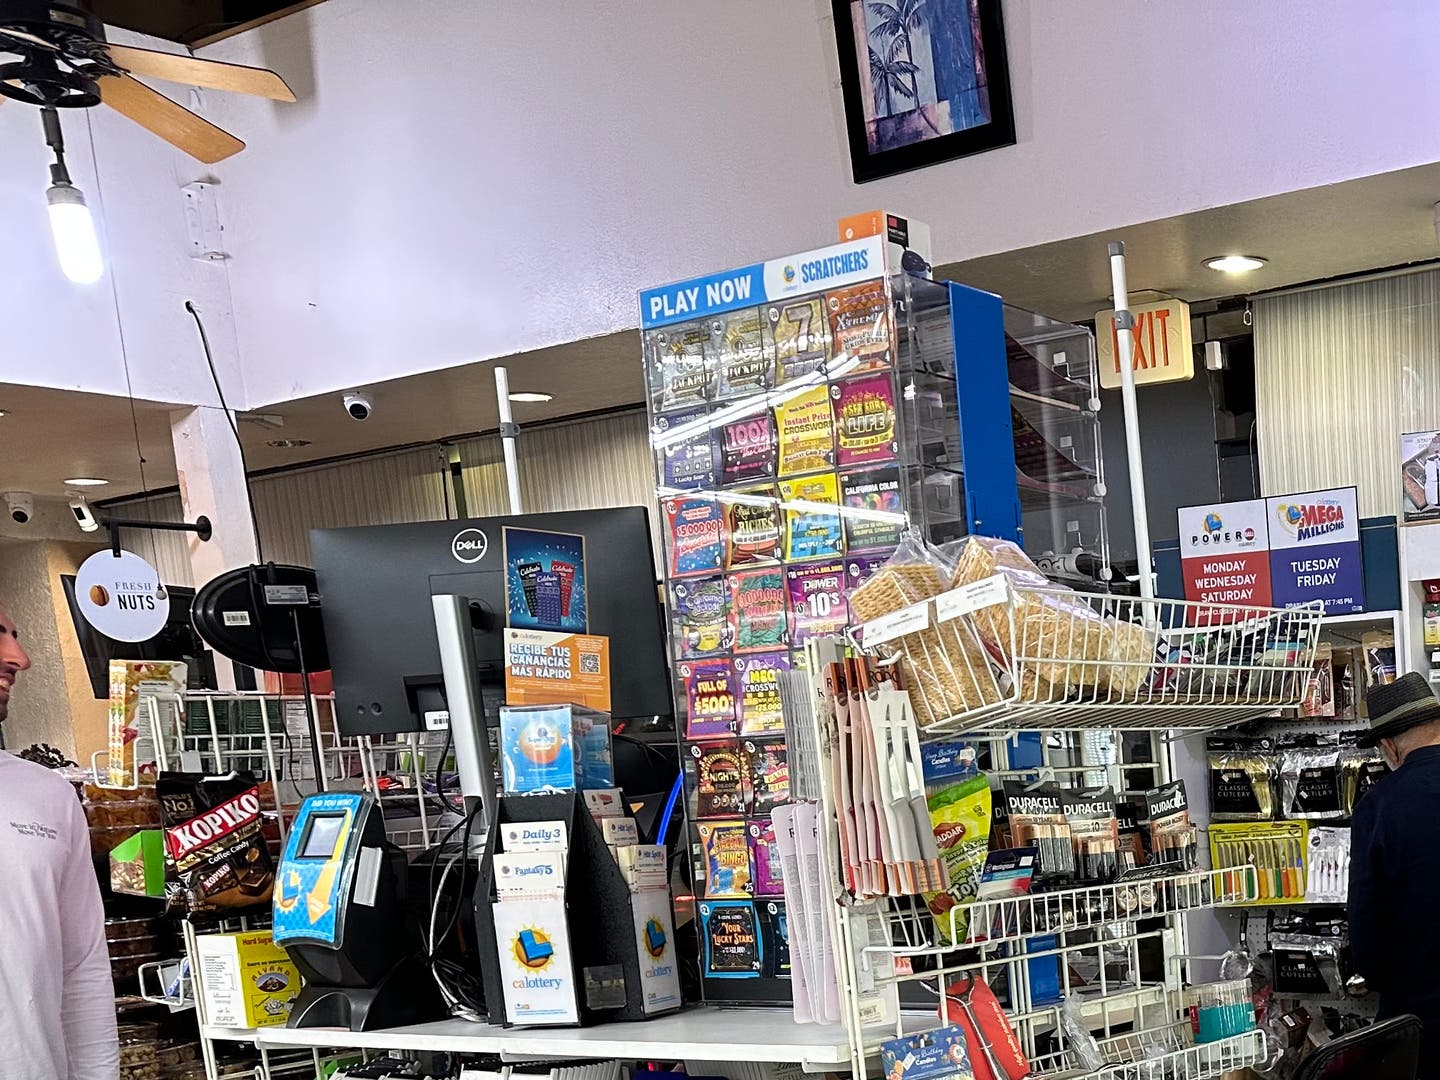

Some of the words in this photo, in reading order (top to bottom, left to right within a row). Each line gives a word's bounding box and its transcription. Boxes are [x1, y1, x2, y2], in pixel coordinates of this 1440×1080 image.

[801, 250, 867, 283] SCRATCHERS
[651, 288, 700, 320] PLAY
[707, 275, 752, 306] NOW
[848, 413, 886, 434] LIFE
[845, 485, 878, 495] CALIFORNIA
[880, 481, 898, 491] COLOR
[1299, 504, 1344, 528] MEGA
[1298, 521, 1344, 541] MILLIONS
[457, 538, 484, 551] DELL
[1203, 560, 1246, 574] MONDAY
[1291, 558, 1341, 572] TUESDAY
[114, 581, 152, 592] FRESH
[803, 577, 839, 592] POWER
[1195, 574, 1257, 589] WEDNESDAY
[1298, 573, 1336, 588] FRIDAY
[118, 594, 156, 611] NUTS
[1201, 588, 1254, 603] SATURDAY
[510, 643, 547, 656] RECIBE
[551, 646, 571, 658] TUS
[510, 655, 571, 668] GANANCIAS
[698, 681, 715, 692] FULL
[710, 771, 740, 782] NIGHTS
[1218, 784, 1249, 792] CLASSIC
[1218, 790, 1250, 798] CUTLERY
[1008, 796, 1060, 811] DURACELL
[1064, 801, 1112, 816] DURACELL
[173, 794, 260, 854] KOPIKO
[522, 829, 550, 842] Daily
[552, 828, 560, 838] 3
[208, 850, 231, 865] Coffee
[231, 840, 250, 854] Candy
[720, 850, 748, 866] BINGO
[204, 863, 231, 890] KOPIKO
[514, 866, 544, 876] Fantasy
[721, 922, 741, 934] YOUR
[242, 938, 256, 946] Hard
[713, 934, 732, 945] LUCKY
[734, 933, 754, 944] STARS
[512, 977, 562, 990] calottery
[916, 1056, 936, 1066] Candles
